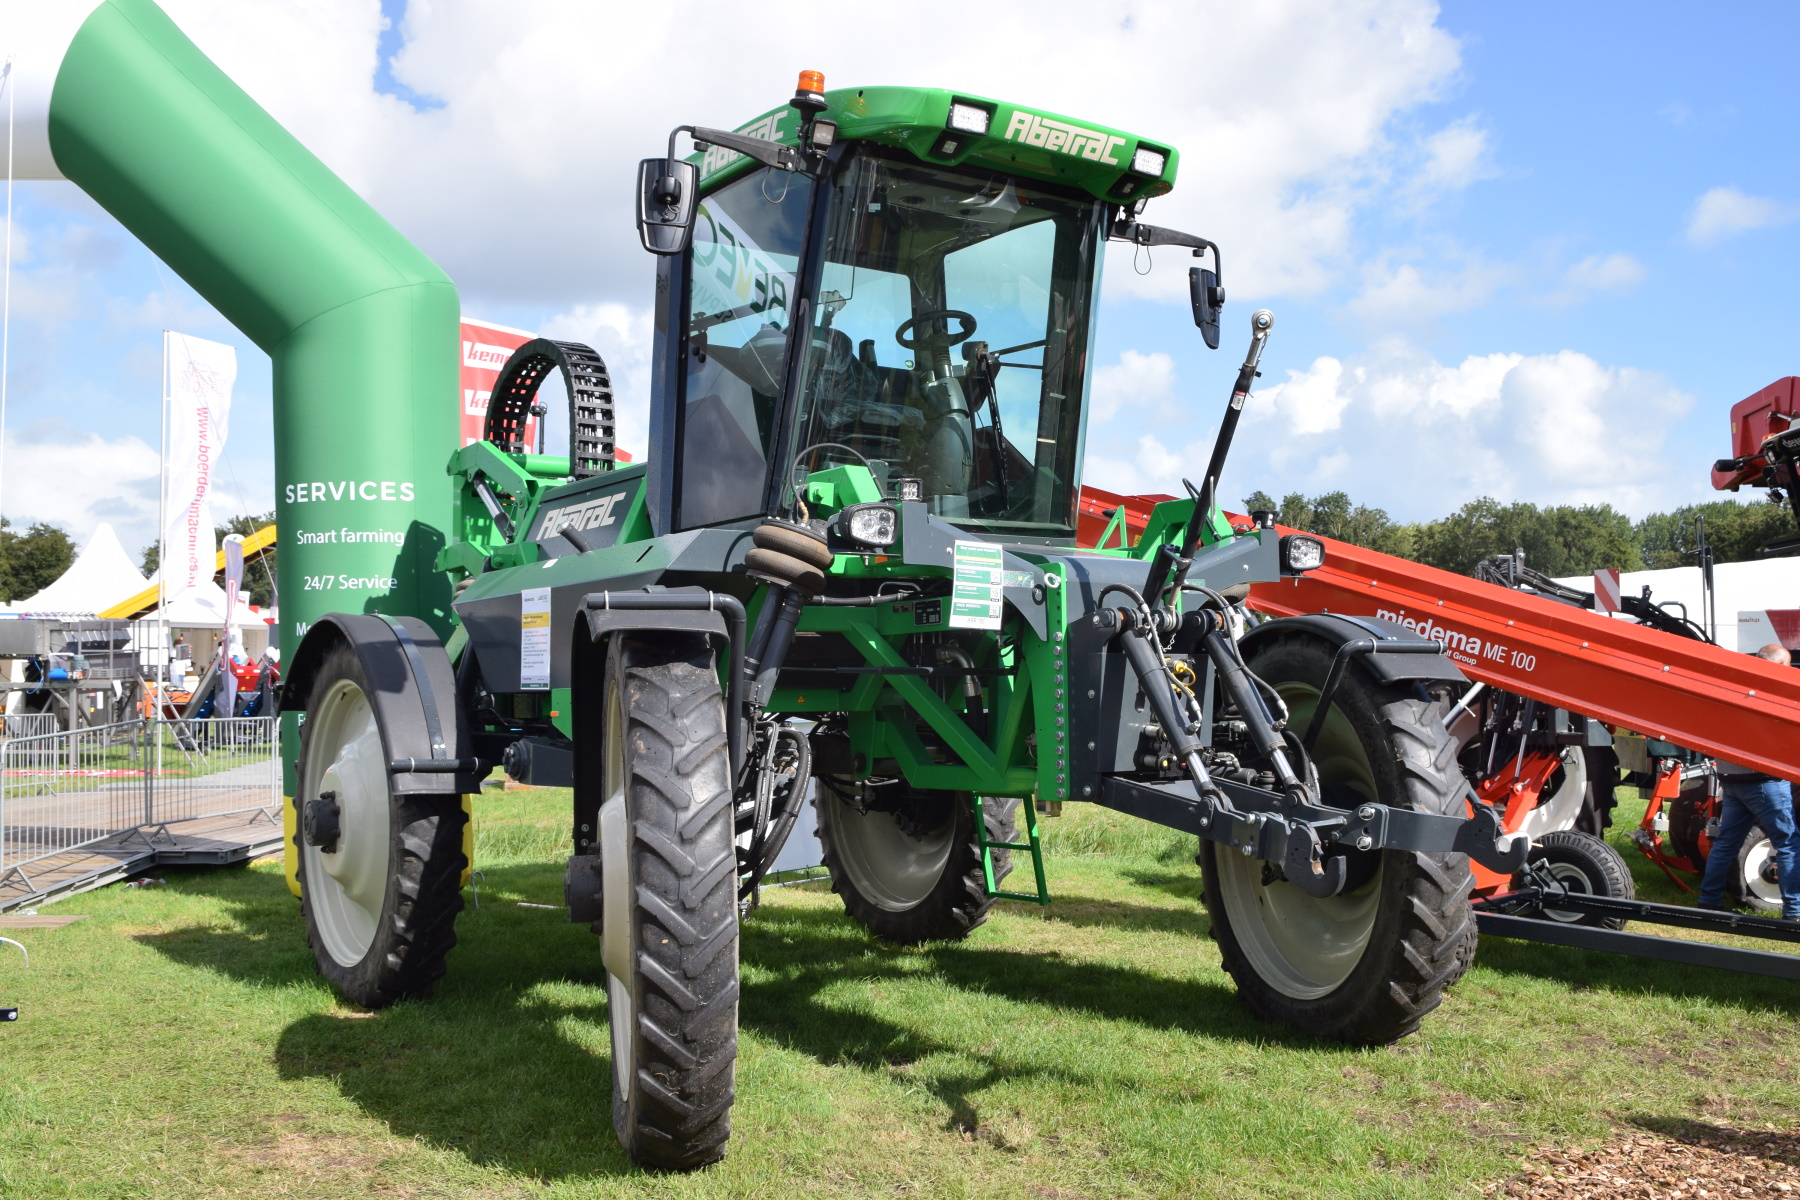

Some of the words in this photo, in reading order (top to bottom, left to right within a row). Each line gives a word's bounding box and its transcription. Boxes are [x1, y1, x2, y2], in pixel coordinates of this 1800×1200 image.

[285, 481, 415, 504] SERVICES
[296, 529, 337, 545] Smart
[340, 528, 405, 546] farming
[303, 574, 335, 590] 24/7
[338, 574, 398, 589] Service
[1375, 608, 1482, 656] miedema
[1483, 641, 1508, 664] ME
[1510, 650, 1536, 672] 100
[1453, 651, 1477, 666] Group
